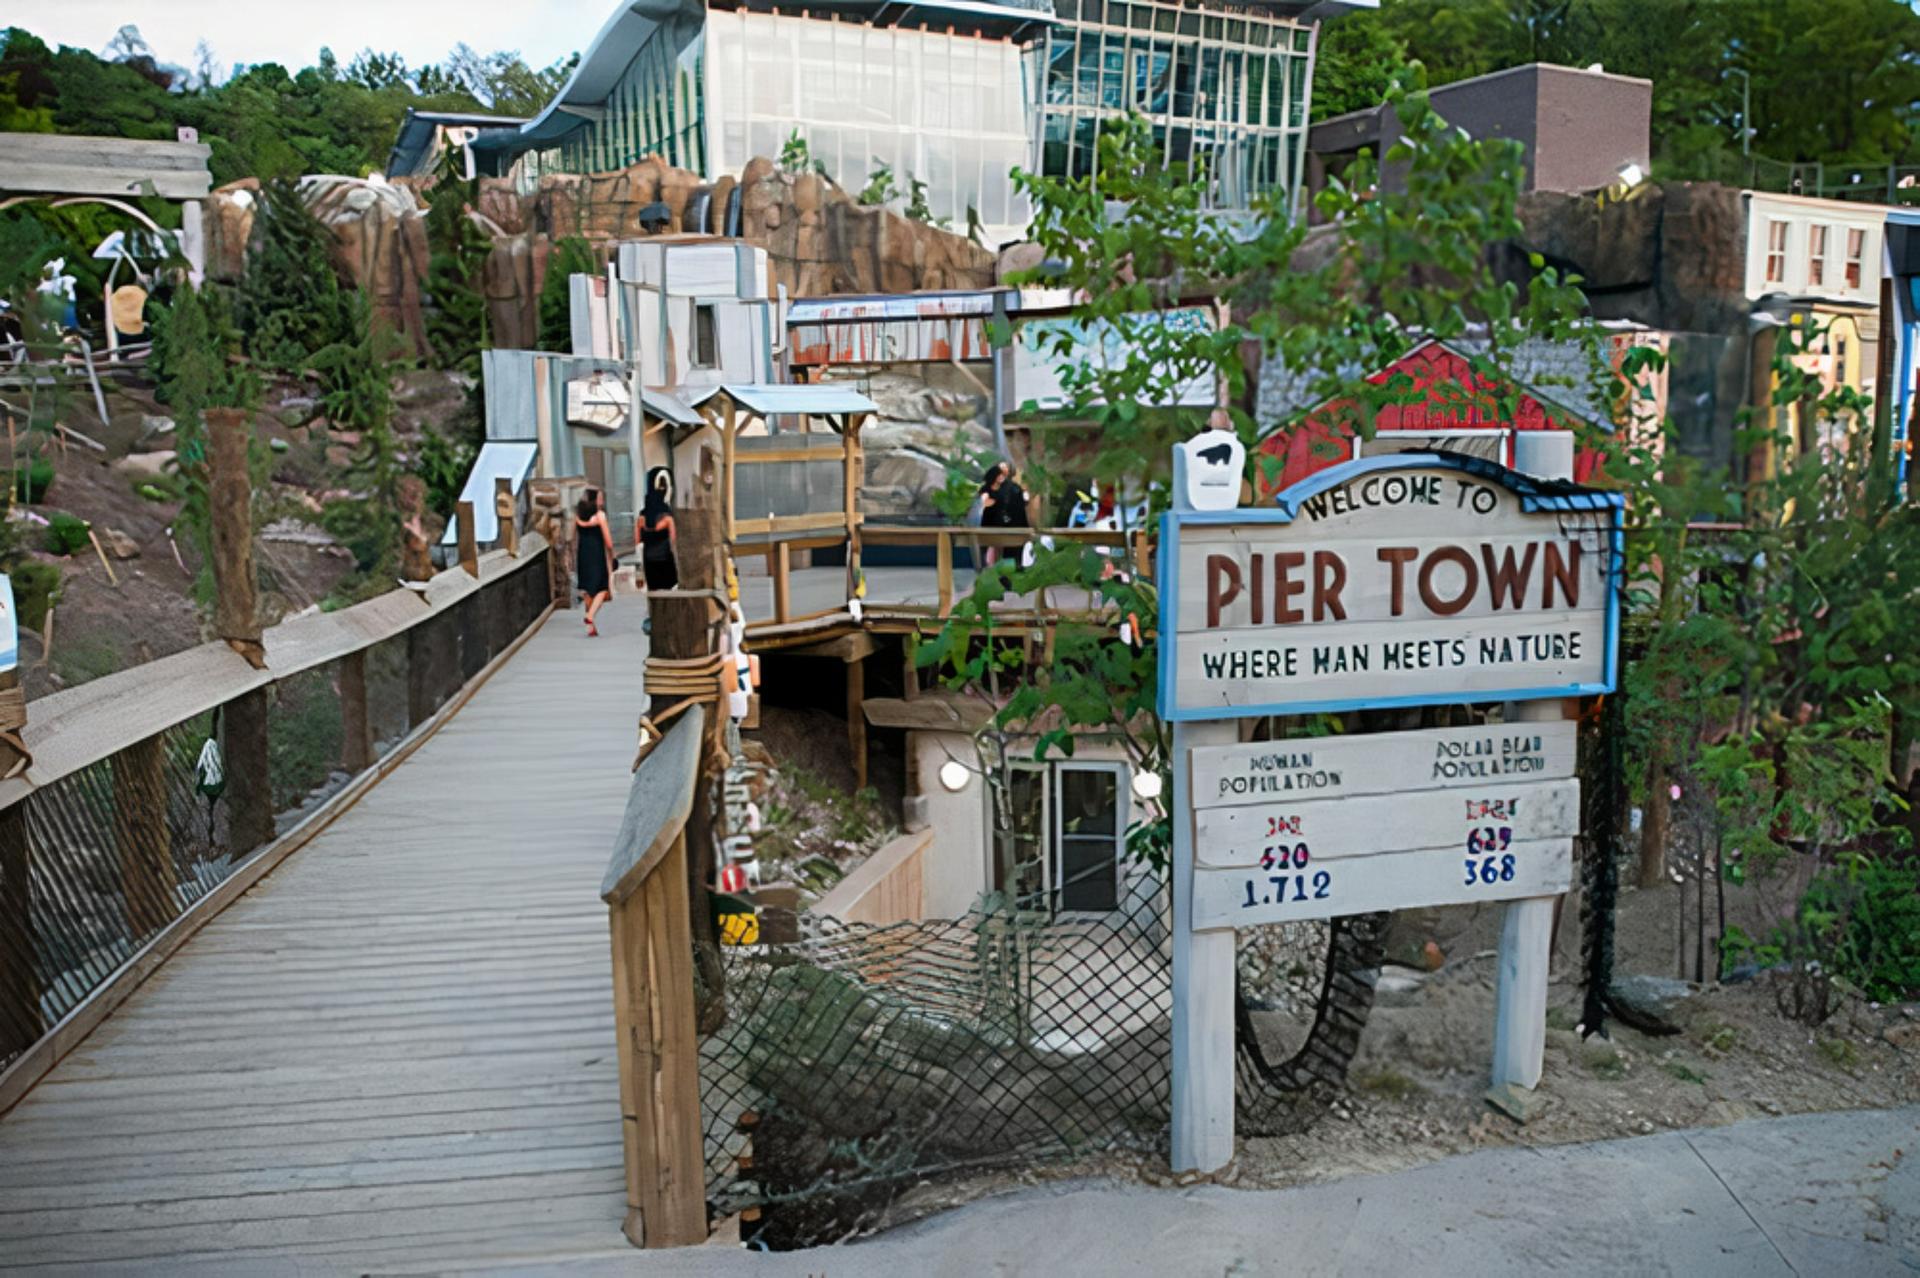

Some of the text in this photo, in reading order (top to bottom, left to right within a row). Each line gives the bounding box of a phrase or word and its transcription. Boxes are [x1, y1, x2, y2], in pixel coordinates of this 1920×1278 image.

[1302, 475, 1498, 522] WELCOME TO
[1207, 540, 1581, 628] PIER TOWN
[1203, 632, 1582, 679] WHERE MAN MEETS NATURE
[1464, 853, 1516, 886] 368
